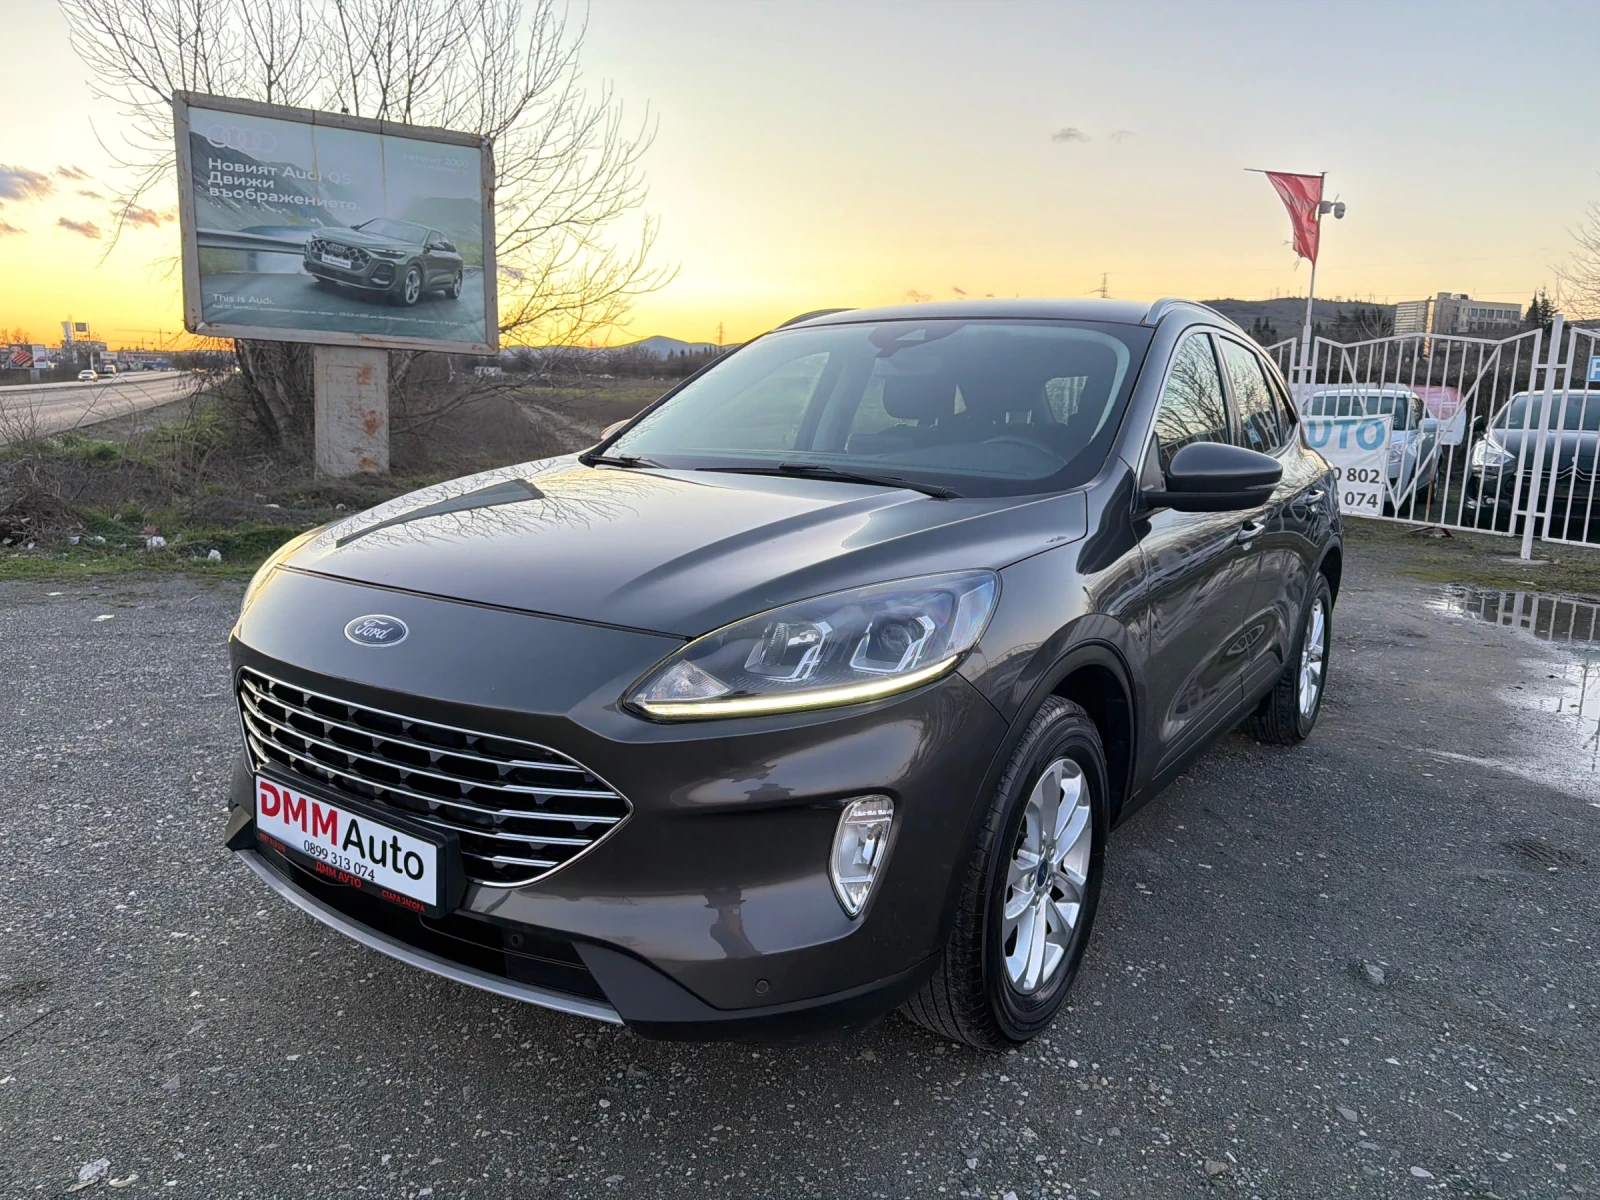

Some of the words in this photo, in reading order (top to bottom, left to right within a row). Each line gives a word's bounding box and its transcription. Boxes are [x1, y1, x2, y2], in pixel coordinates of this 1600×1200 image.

[208, 158, 277, 176] Новият
[282, 166, 322, 181] Audi
[208, 172, 274, 188] Движи
[212, 293, 234, 302] This
[237, 295, 246, 303] is
[248, 295, 275, 305] Audi.
[1307, 418, 1385, 450] UTO
[1346, 468, 1380, 484] 802
[1344, 491, 1378, 508] 074
[354, 618, 394, 640] Ford
[304, 840, 328, 860] 0899
[330, 851, 350, 871] 313
[354, 862, 375, 881] 074
[315, 861, 336, 879] ДММ
[338, 871, 362, 888] АУТО
[382, 889, 401, 903] СТАРА
